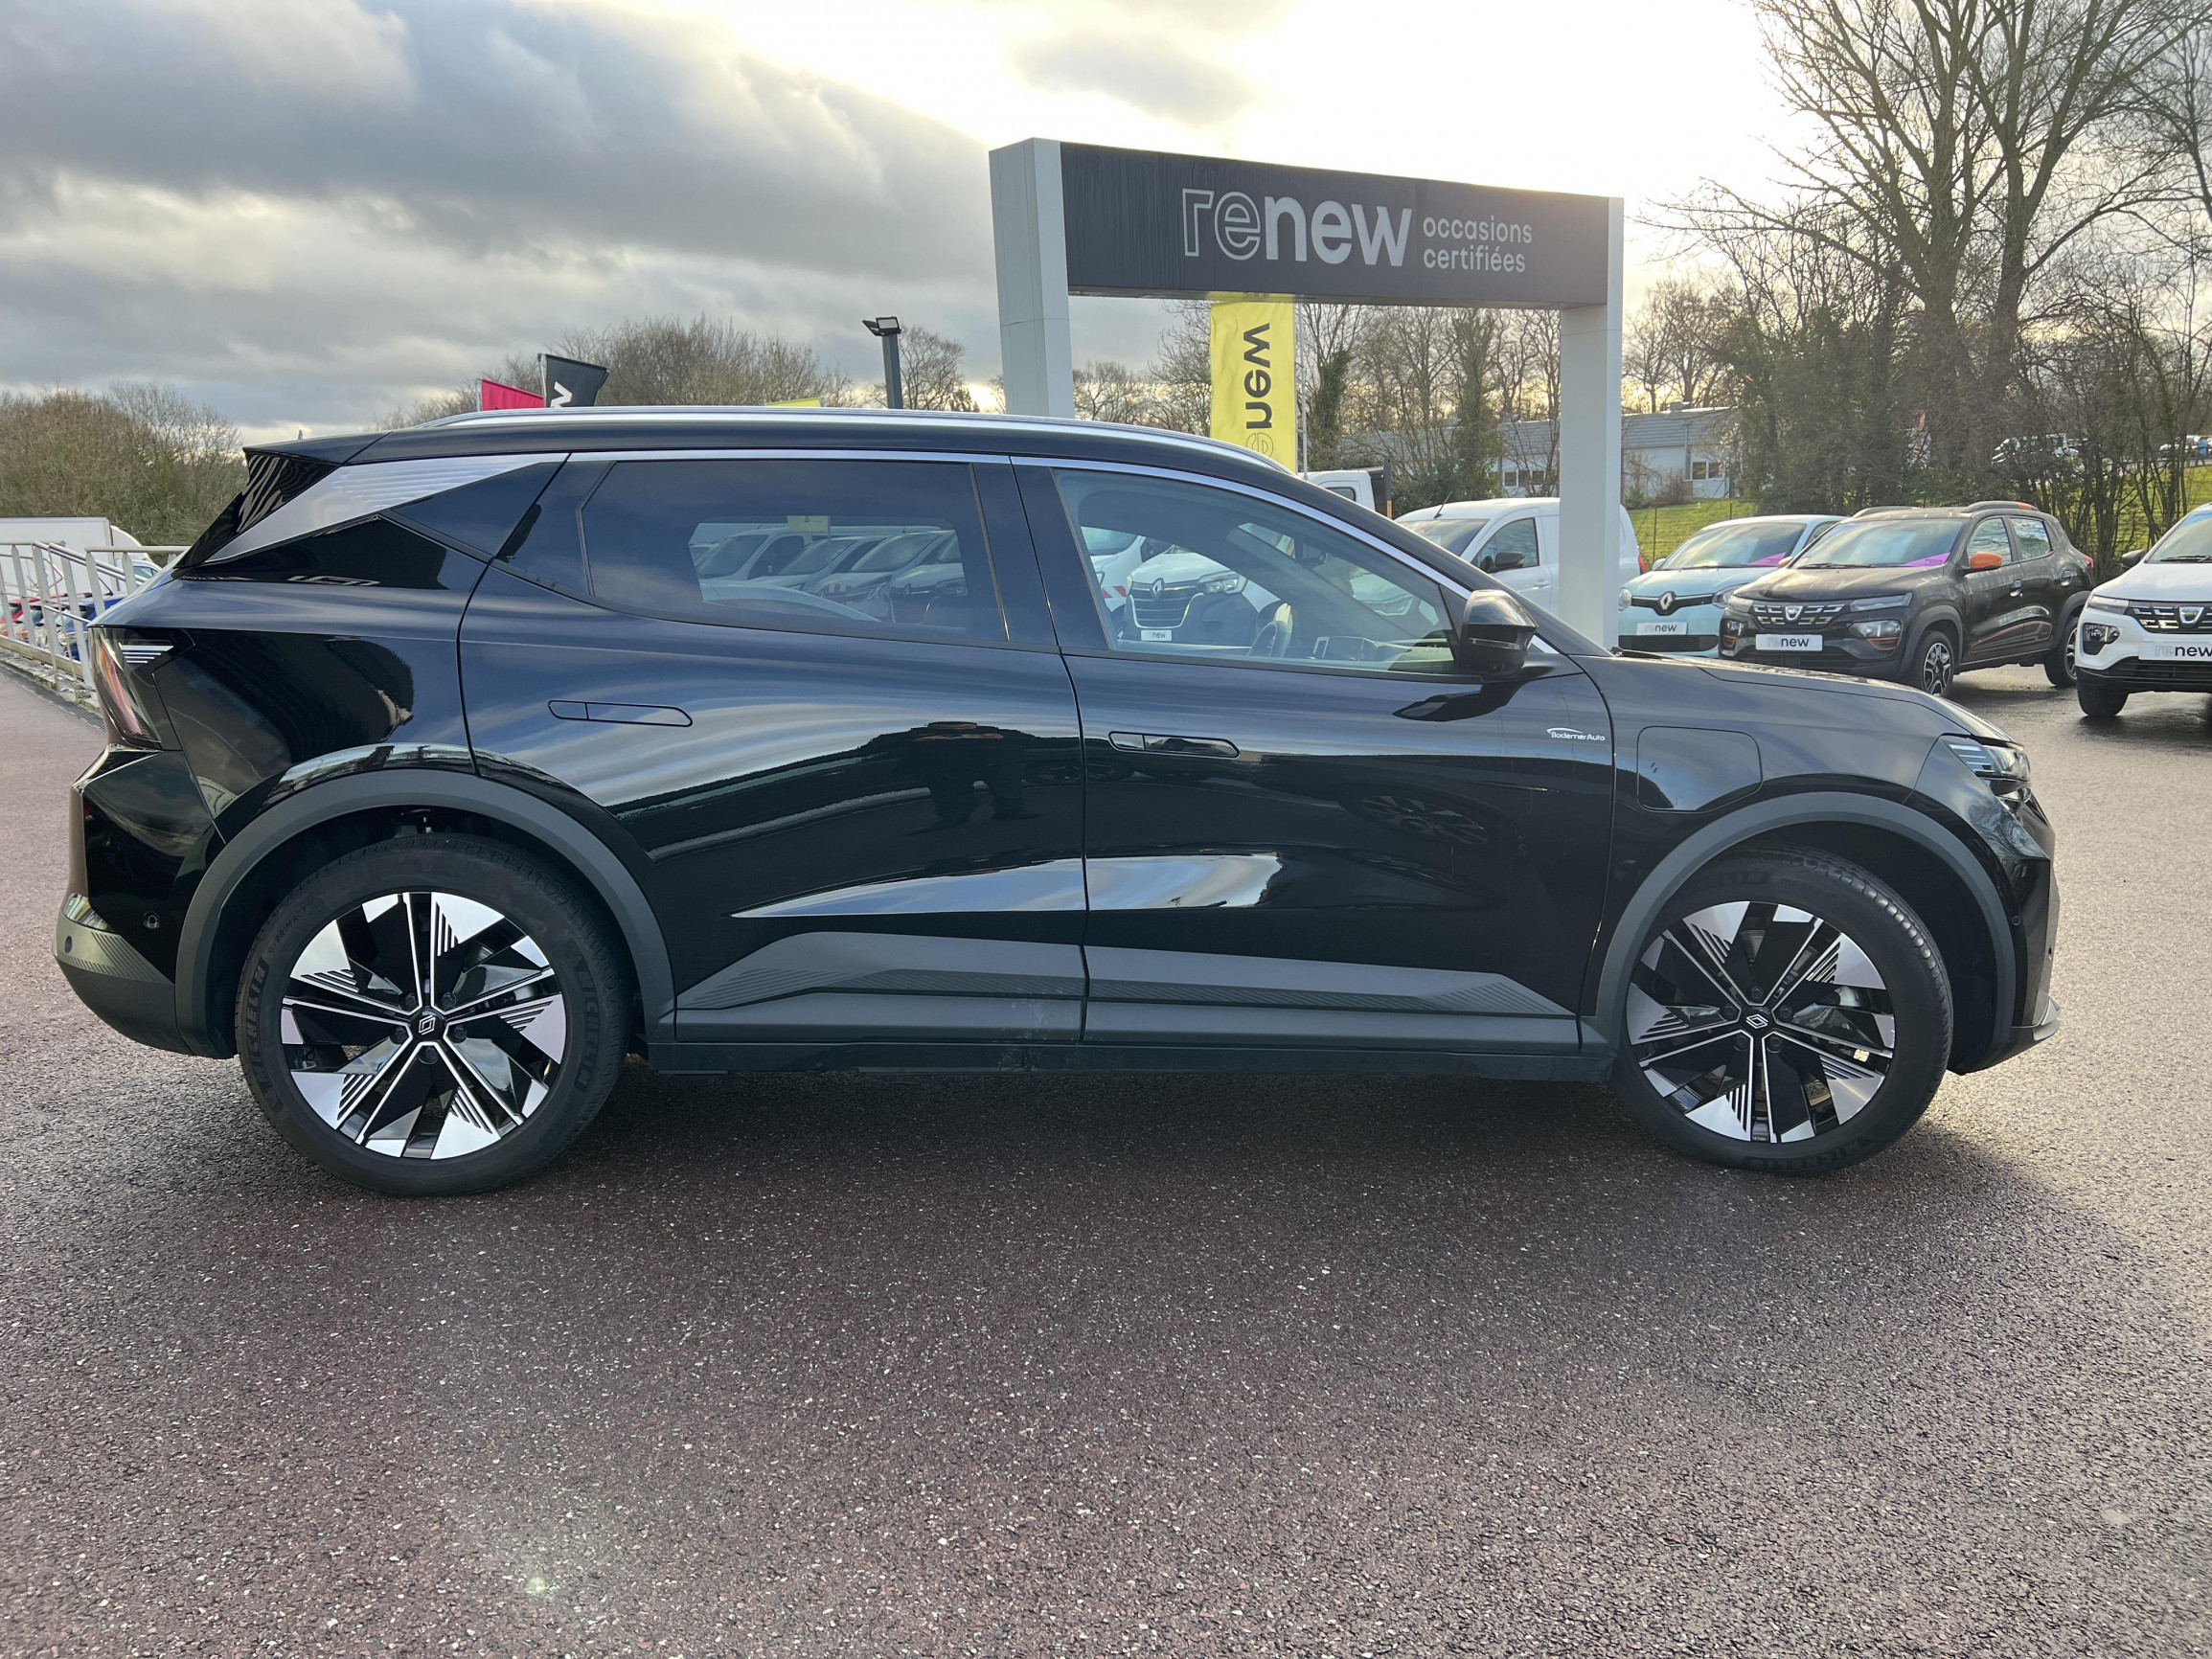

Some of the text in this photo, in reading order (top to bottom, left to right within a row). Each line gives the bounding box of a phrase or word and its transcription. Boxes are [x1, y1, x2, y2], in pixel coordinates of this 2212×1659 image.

[1181, 187, 1413, 267] renew
[1424, 215, 1533, 244] occasions
[1424, 245, 1526, 273] certifiées
[245, 965, 270, 1083] MICHELIN
